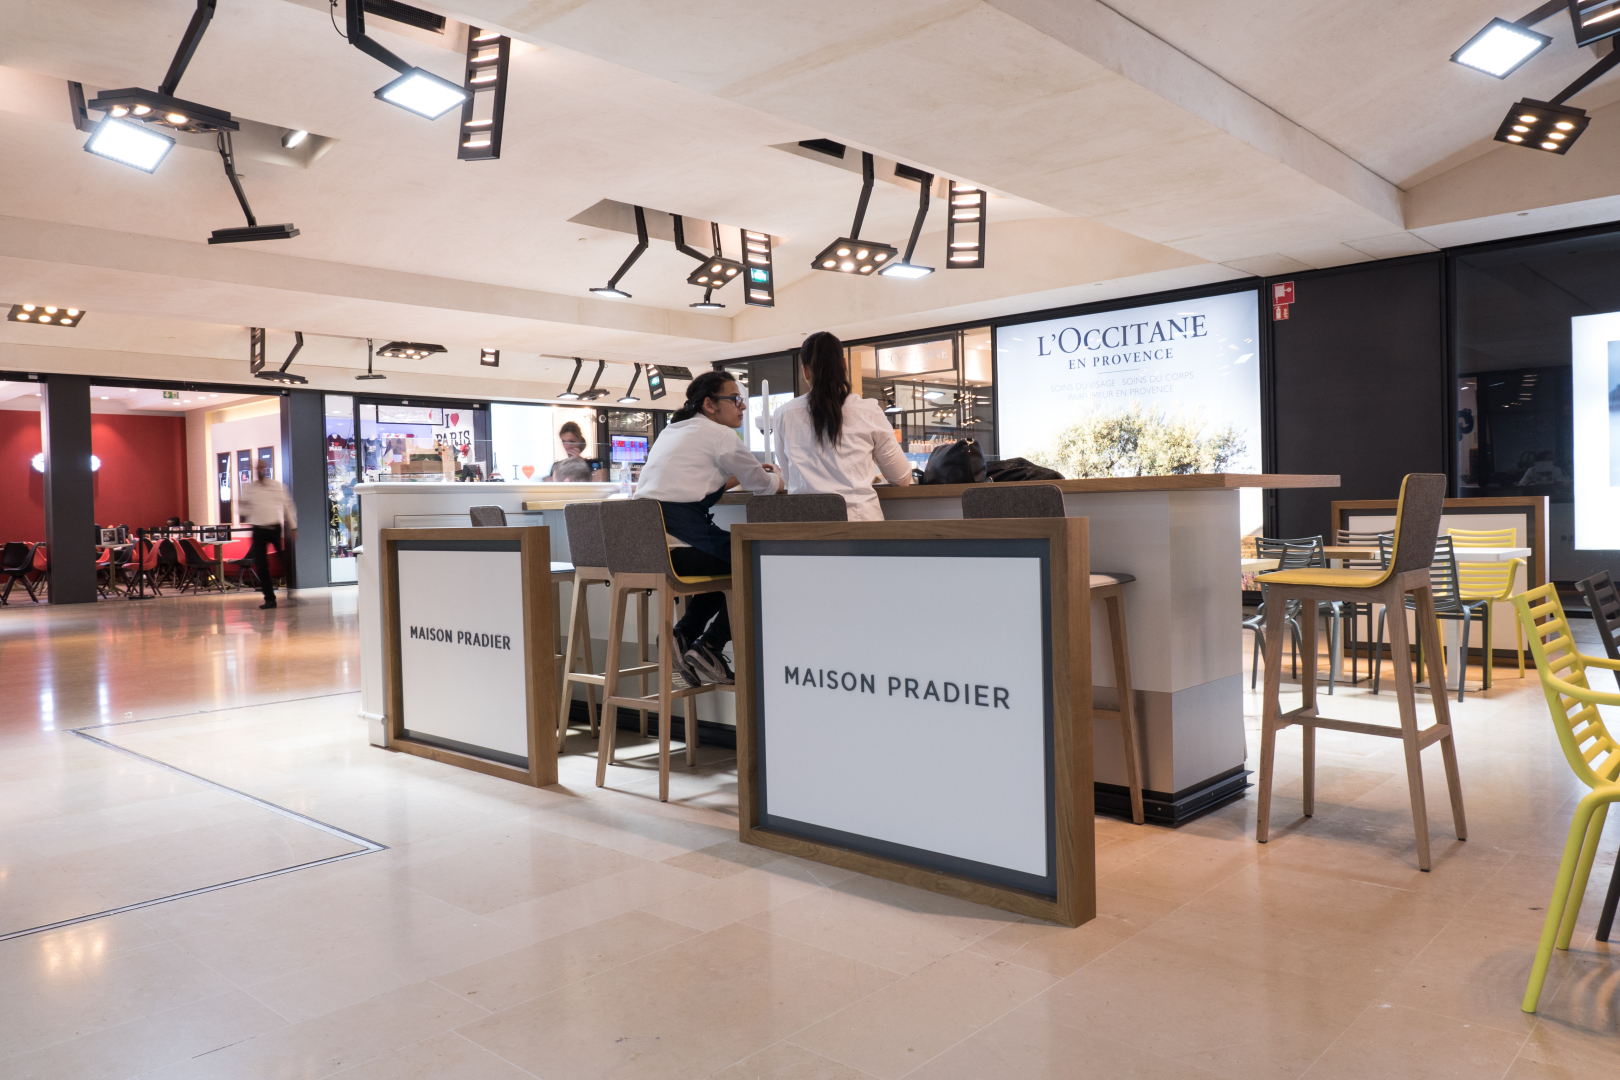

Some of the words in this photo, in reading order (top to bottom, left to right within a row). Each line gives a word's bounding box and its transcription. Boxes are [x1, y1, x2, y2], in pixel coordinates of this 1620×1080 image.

[1037, 315, 1208, 357] L'OCCITANE
[1069, 357, 1086, 370] EN
[1093, 348, 1174, 368] PROVENCE
[1050, 383, 1074, 393] SOINS
[1075, 382, 1088, 391] DU
[1089, 379, 1116, 389] VISAGE
[1122, 376, 1147, 386] SOINS
[1149, 374, 1163, 383] DU
[1165, 371, 1194, 382] CORPS
[1068, 390, 1114, 401] PARFUMEUR
[1115, 389, 1127, 397] EN
[1129, 384, 1174, 396] PROVENCE
[444, 413, 450, 428] I
[435, 430, 471, 446] PARIS
[410, 625, 452, 643] MAISON
[457, 631, 511, 650] PRADIER
[784, 665, 875, 694] MAISON
[888, 676, 1010, 709] PRADIER
